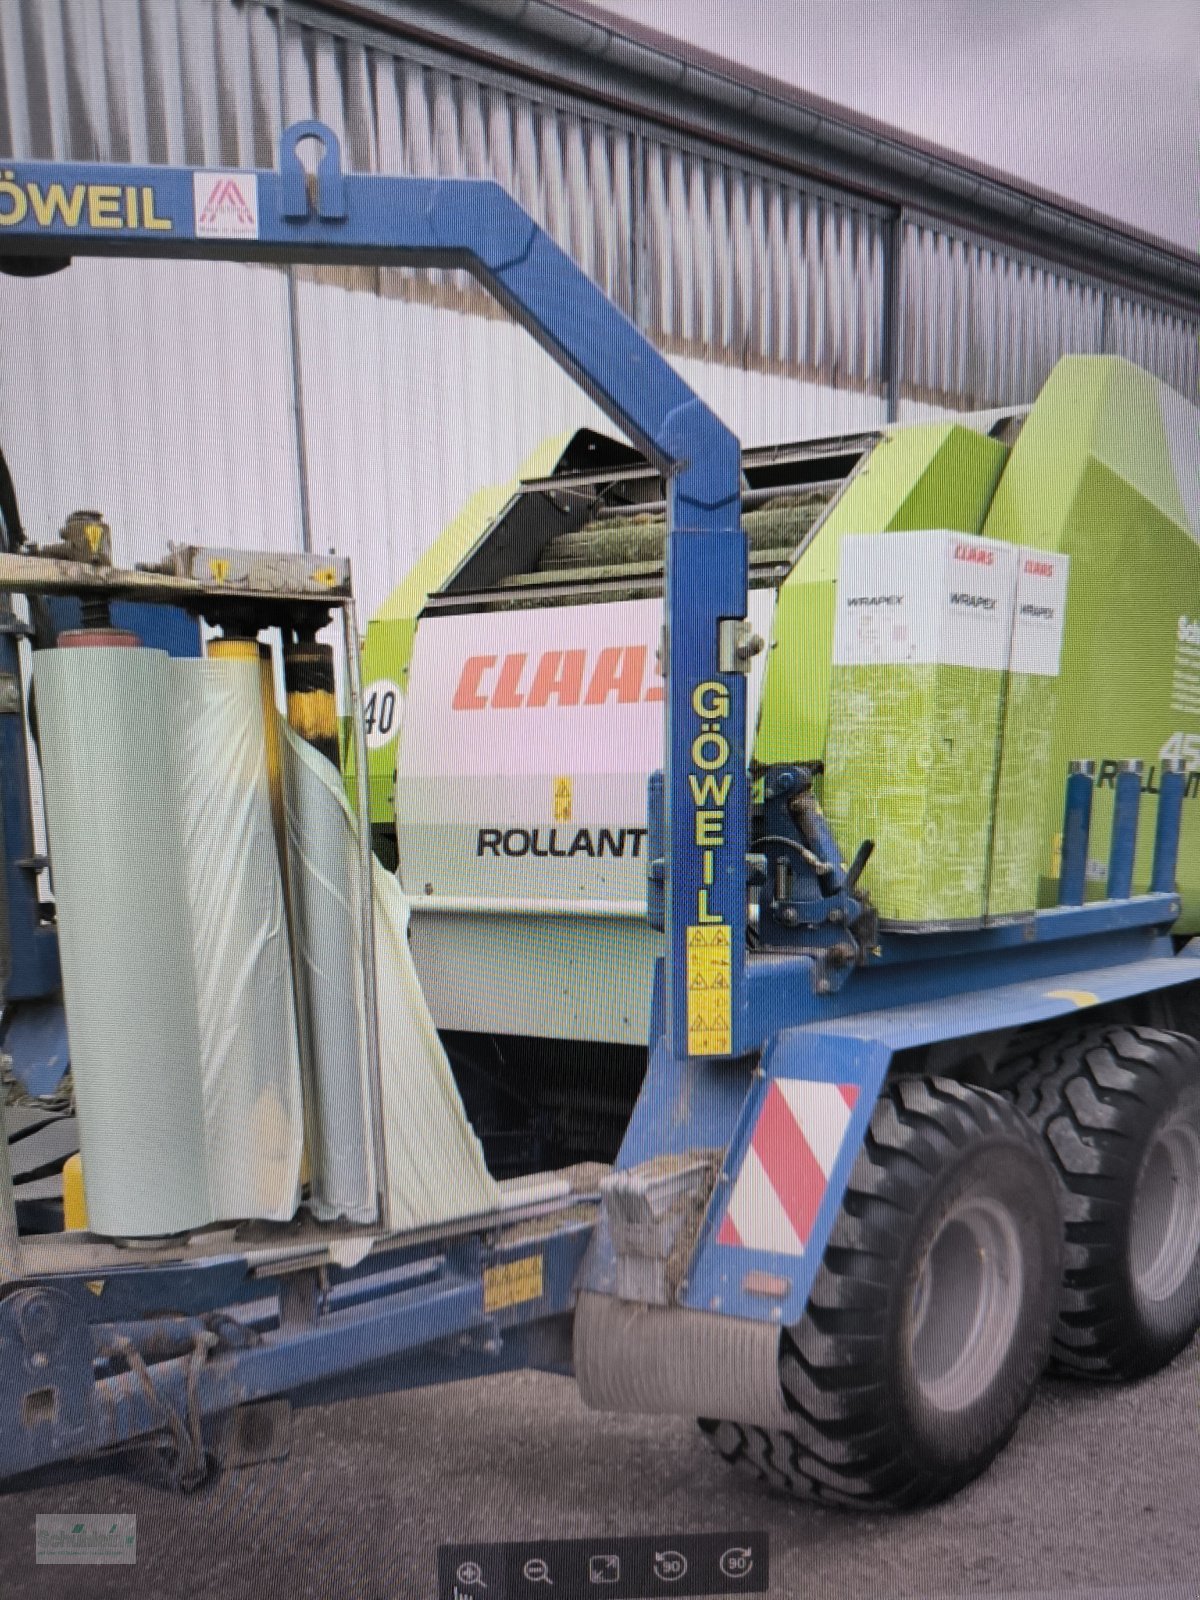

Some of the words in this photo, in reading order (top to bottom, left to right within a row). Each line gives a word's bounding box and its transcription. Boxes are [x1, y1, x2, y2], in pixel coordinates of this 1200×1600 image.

[847, 594, 904, 607] WRAPEX
[950, 592, 997, 611] WRAPEX
[365, 691, 395, 734] 40
[688, 681, 733, 924] GÖWEIL
[477, 828, 648, 858] ROLLANT
[663, 1561, 680, 1572] 90
[729, 1558, 746, 1569] 90
